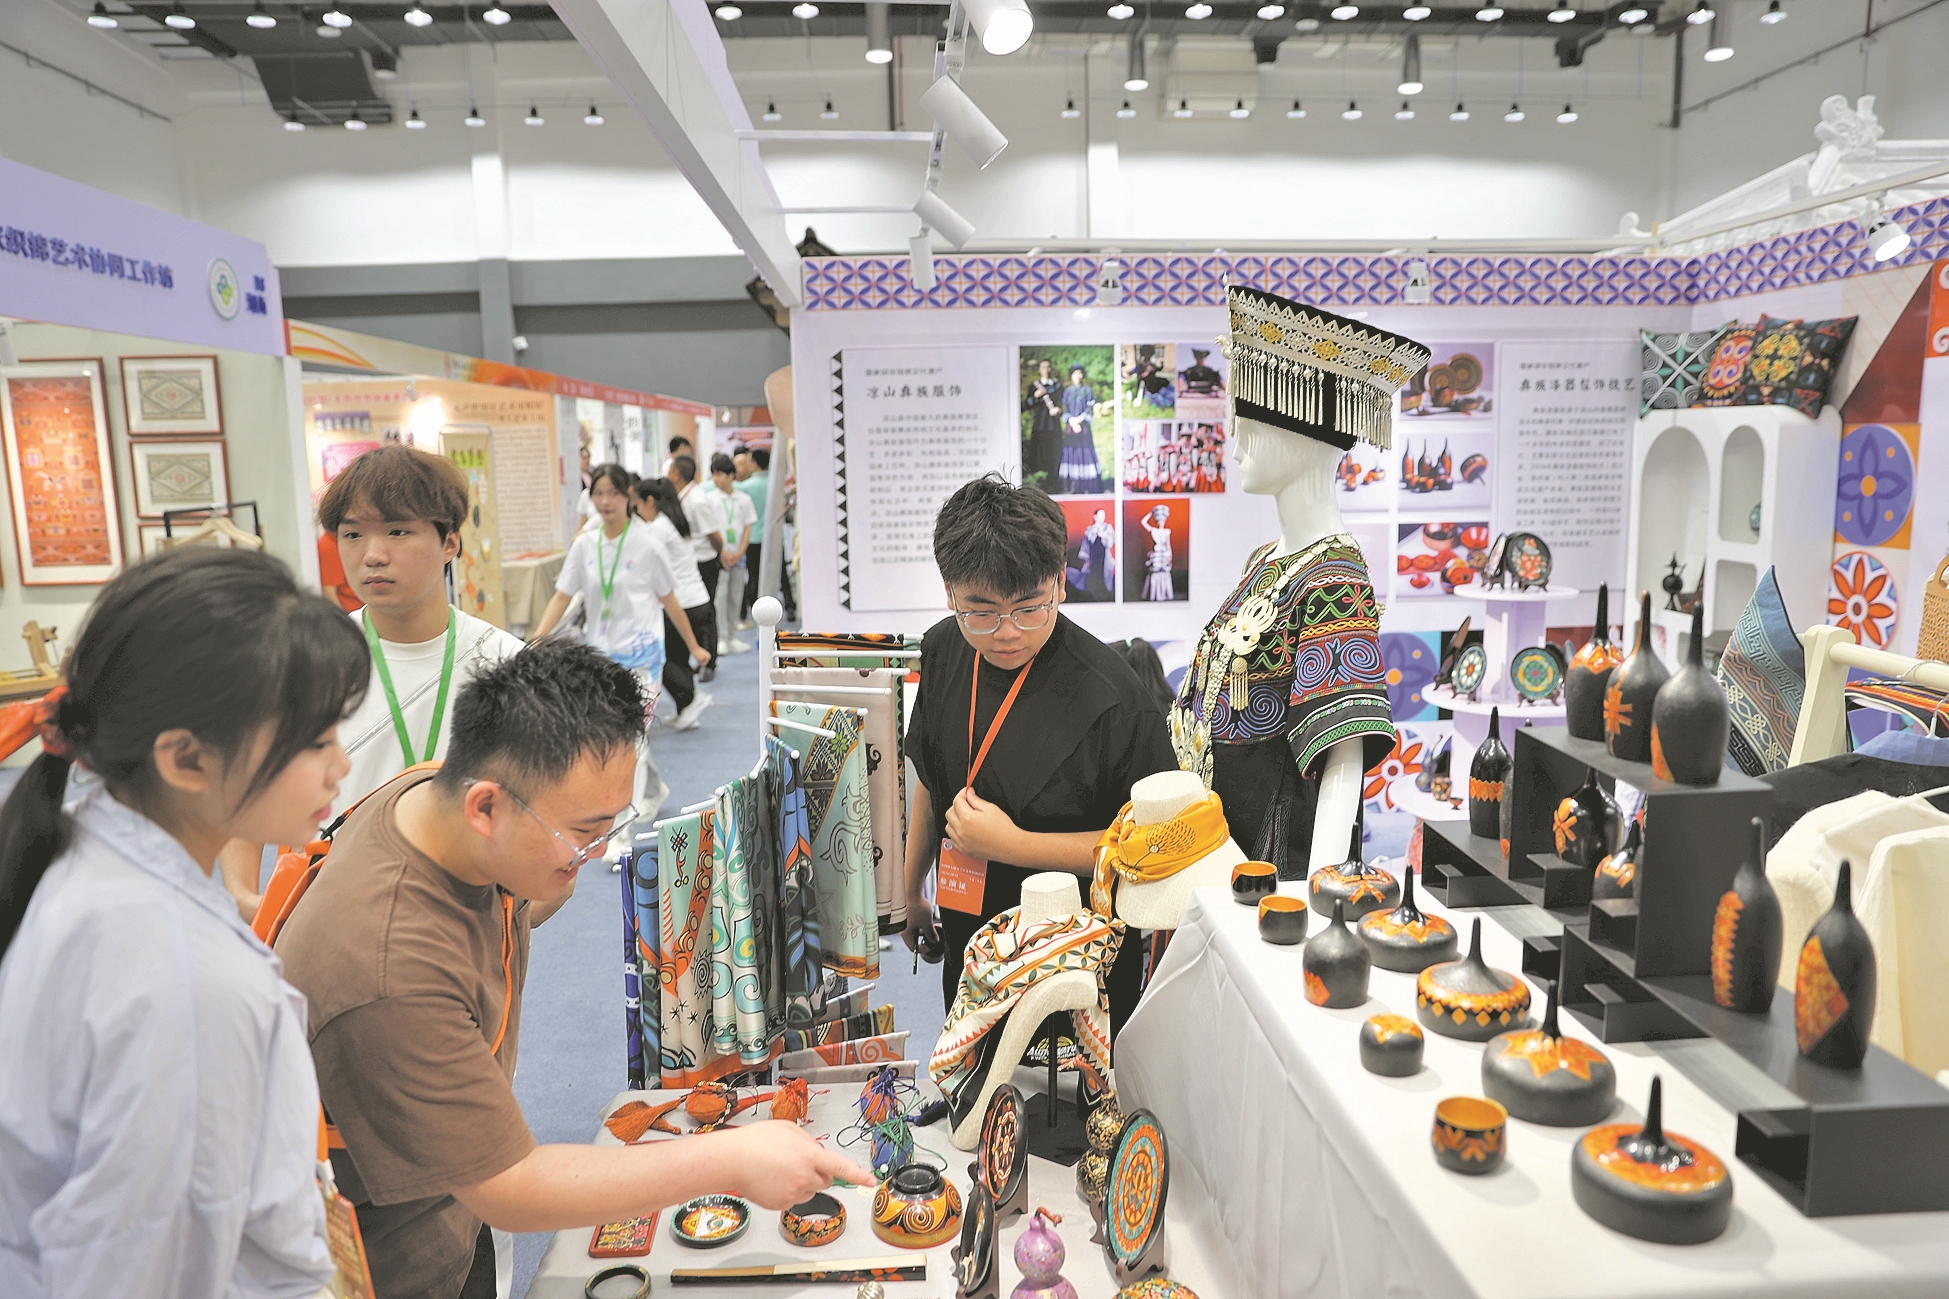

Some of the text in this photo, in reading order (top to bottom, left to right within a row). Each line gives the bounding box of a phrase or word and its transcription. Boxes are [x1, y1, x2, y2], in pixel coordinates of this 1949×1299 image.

[866, 384, 963, 399] 凉山彝族服饰
